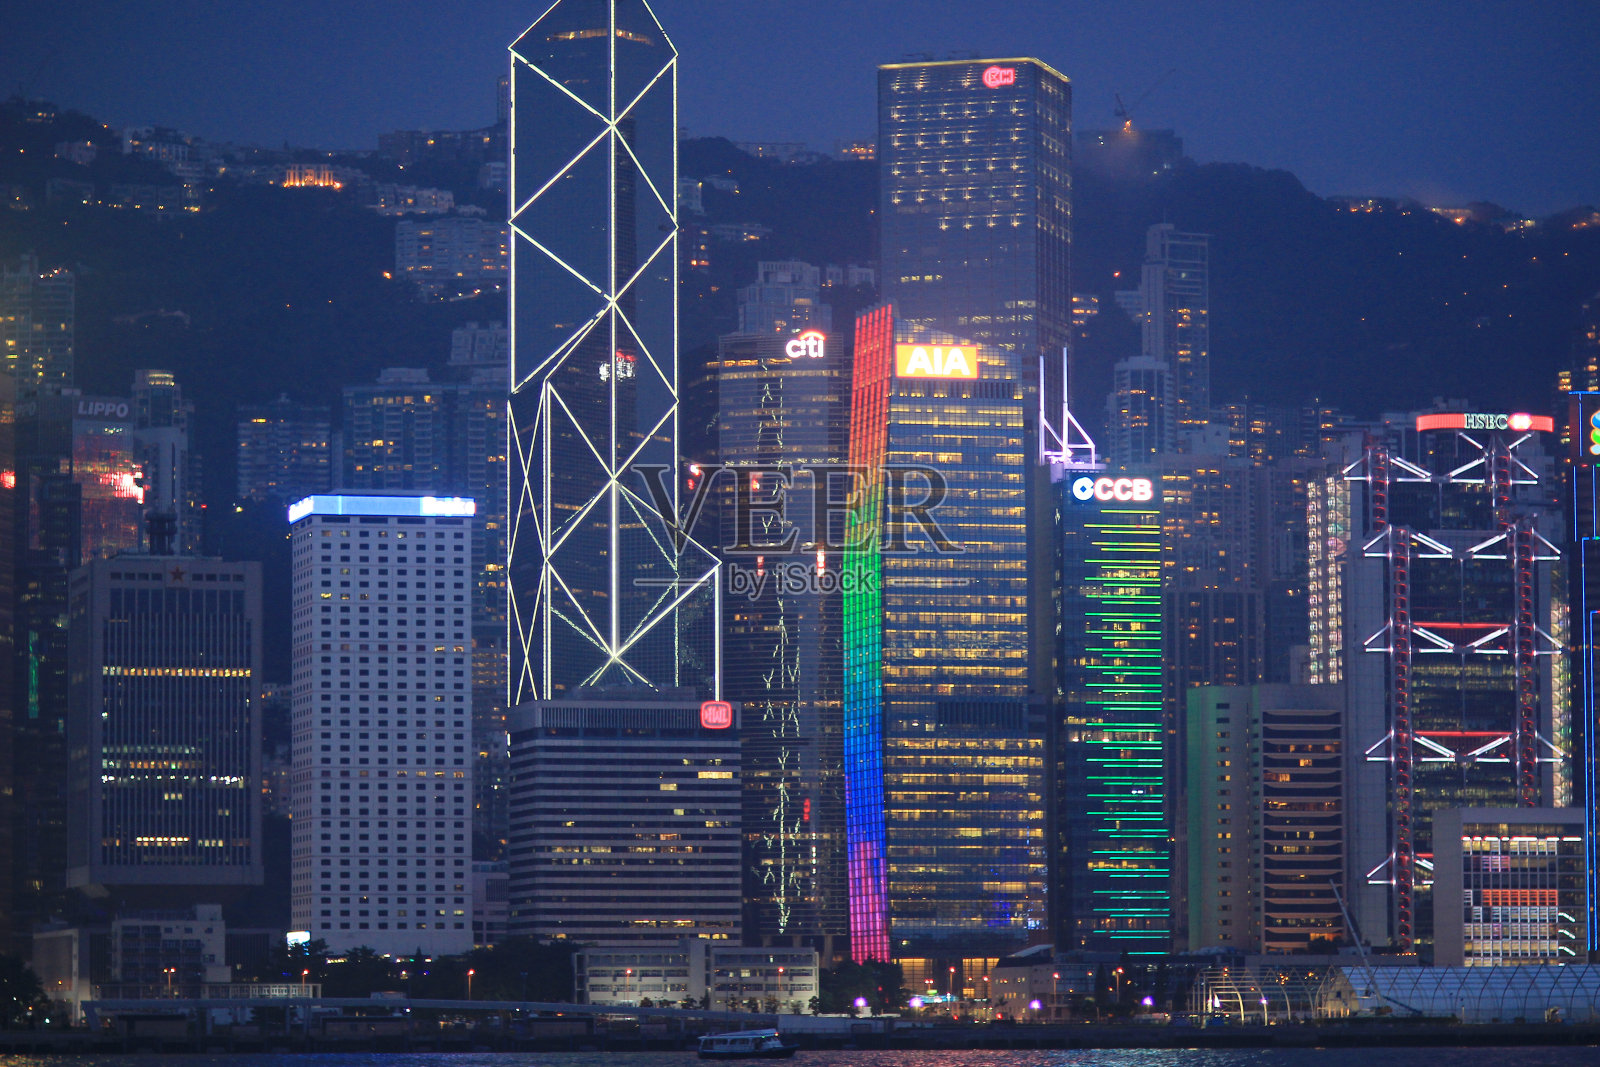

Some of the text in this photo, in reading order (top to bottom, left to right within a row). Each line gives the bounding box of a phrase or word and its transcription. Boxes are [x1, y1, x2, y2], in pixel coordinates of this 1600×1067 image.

[786, 331, 825, 358] citi
[906, 347, 970, 375] AIA
[78, 401, 129, 418] LIPPO
[1464, 413, 1508, 430] HSBC
[1094, 478, 1152, 501] CCB
